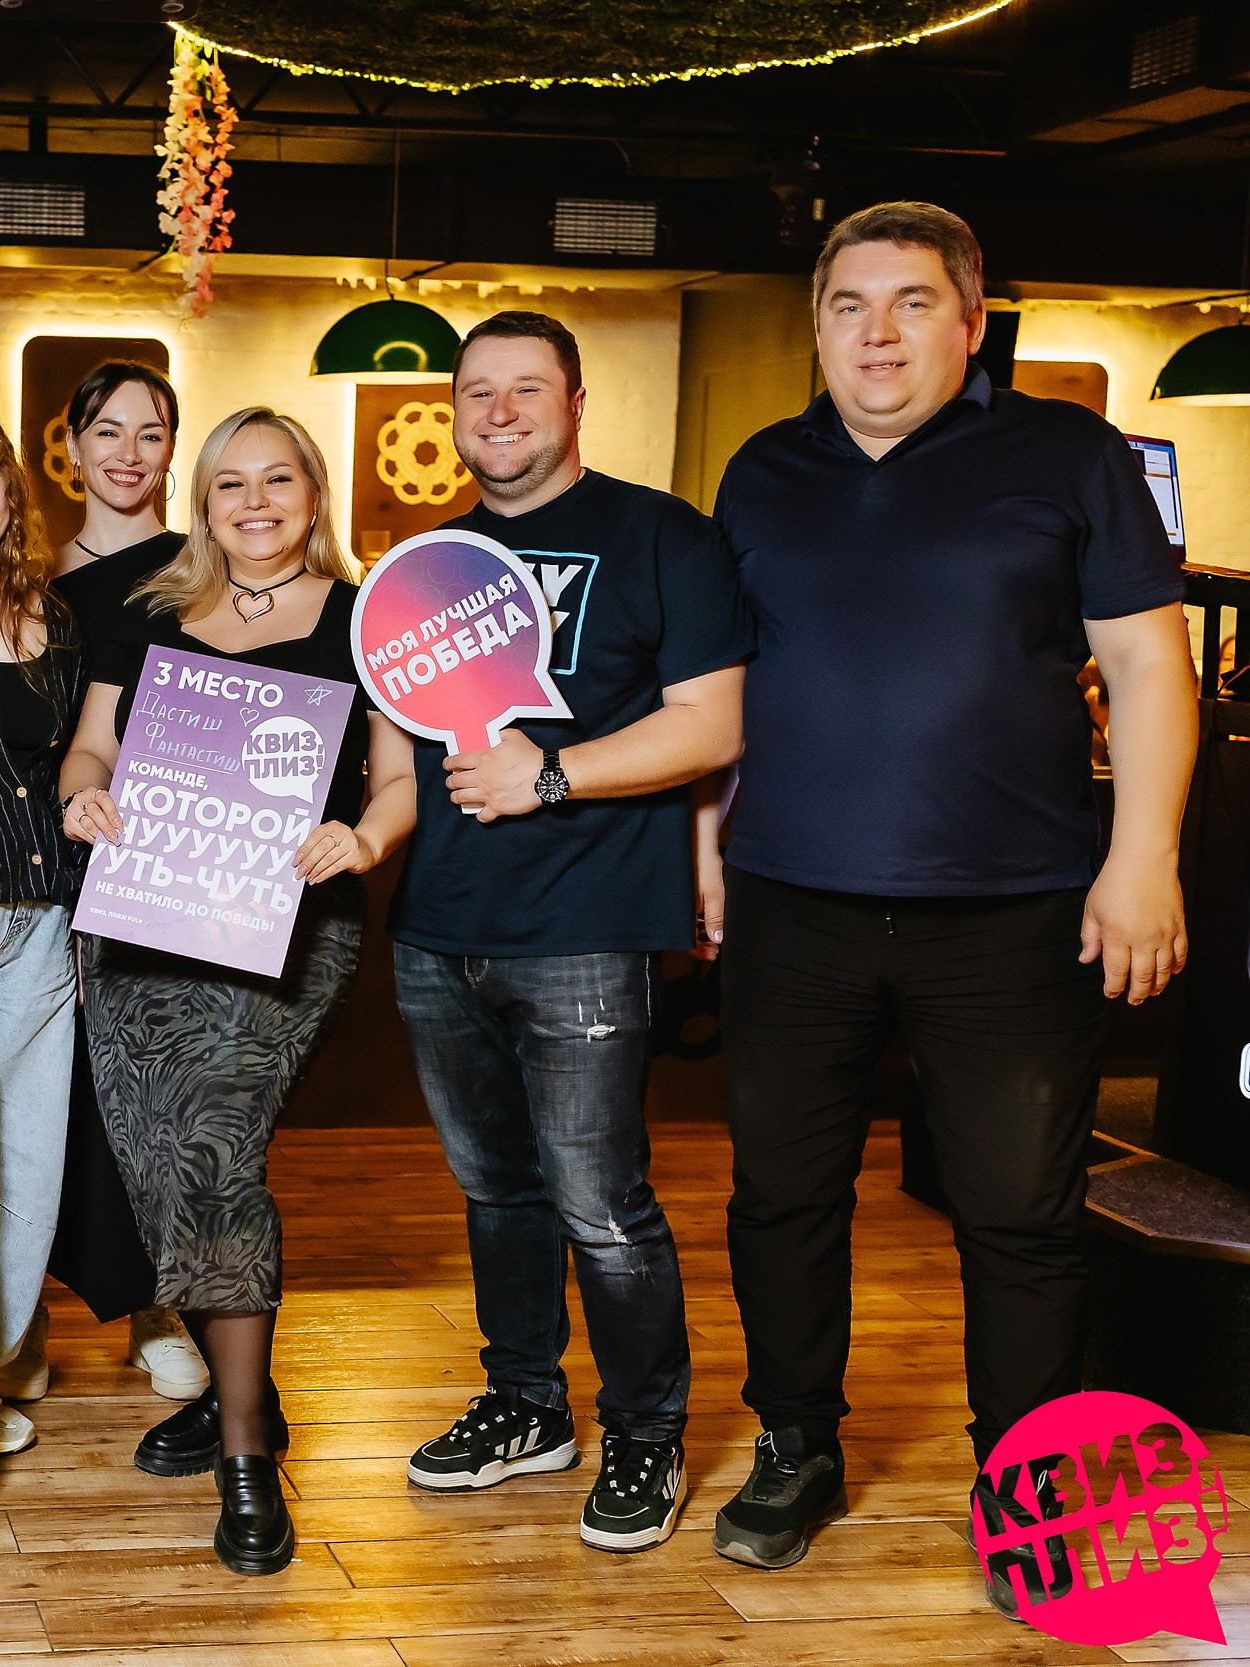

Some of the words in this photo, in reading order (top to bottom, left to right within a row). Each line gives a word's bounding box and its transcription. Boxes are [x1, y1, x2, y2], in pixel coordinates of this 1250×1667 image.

[366, 630, 419, 672] МОЯ
[418, 573, 518, 643] ЛУЧШАЯ
[381, 601, 534, 702] ПОБЕДА
[153, 661, 173, 686] 3
[178, 666, 283, 708] МЕСТО
[128, 760, 208, 790] КОМАНДЕ,
[244, 753, 324, 779] ПЛИЗ!
[118, 778, 312, 846] КОТОРОЙ
[95, 880, 115, 895] НЕ
[116, 885, 184, 911] ХВАТИЛО
[185, 902, 209, 917] ДО
[211, 907, 275, 933] ПОБЕДЫ
